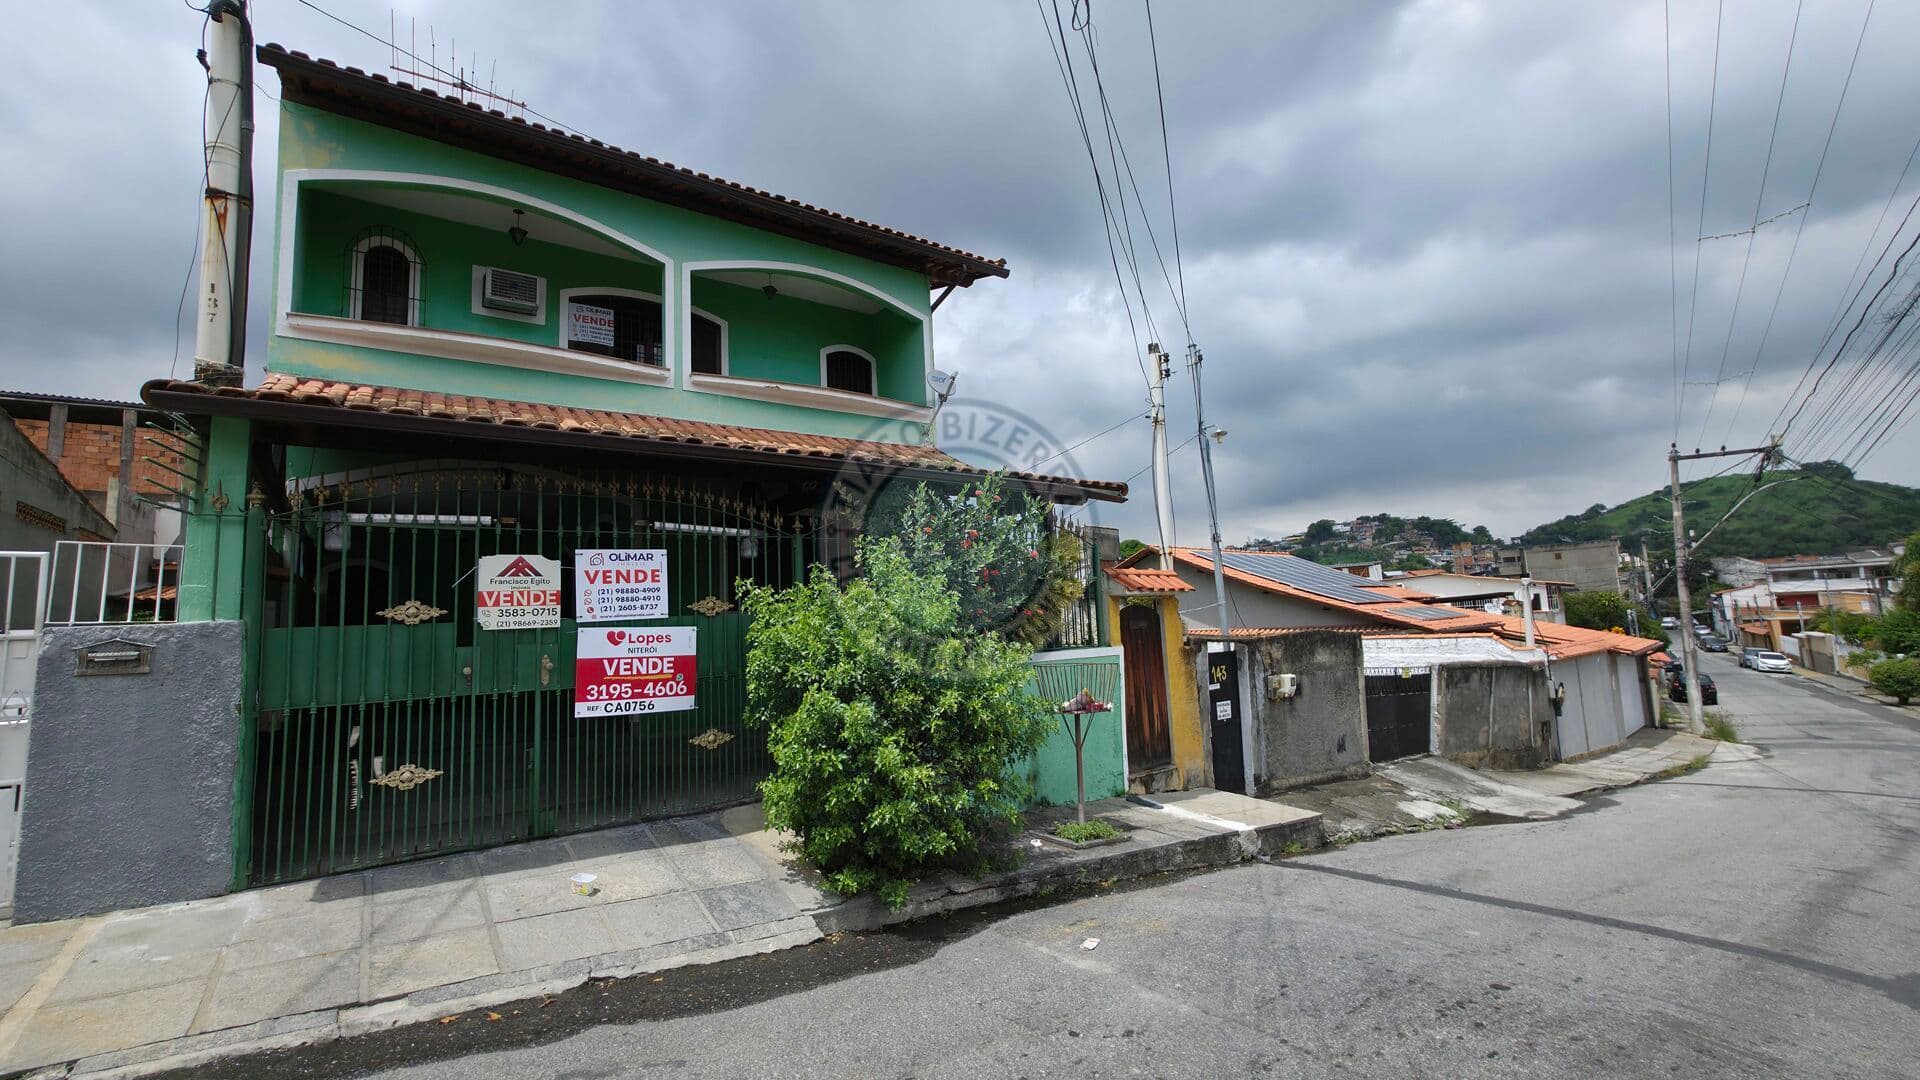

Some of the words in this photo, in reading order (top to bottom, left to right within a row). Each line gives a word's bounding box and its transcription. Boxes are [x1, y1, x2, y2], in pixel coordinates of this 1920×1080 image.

[573, 313, 615, 328] VENDE
[530, 577, 551, 586] Egito
[583, 569, 661, 585] VENDE
[597, 588, 613, 596] (21)
[482, 590, 557, 607] VENDE
[615, 595, 661, 603] 98880-4910
[497, 608, 558, 617] 3583-0715
[600, 605, 616, 613] (21)
[496, 620, 511, 628] (21)
[628, 633, 672, 645] Lopes
[627, 646, 658, 654] NITERÓI
[602, 657, 675, 675] VENDE
[1211, 665, 1227, 683] 143
[586, 680, 688, 700] 3195-4606
[604, 700, 655, 713] CA0756
